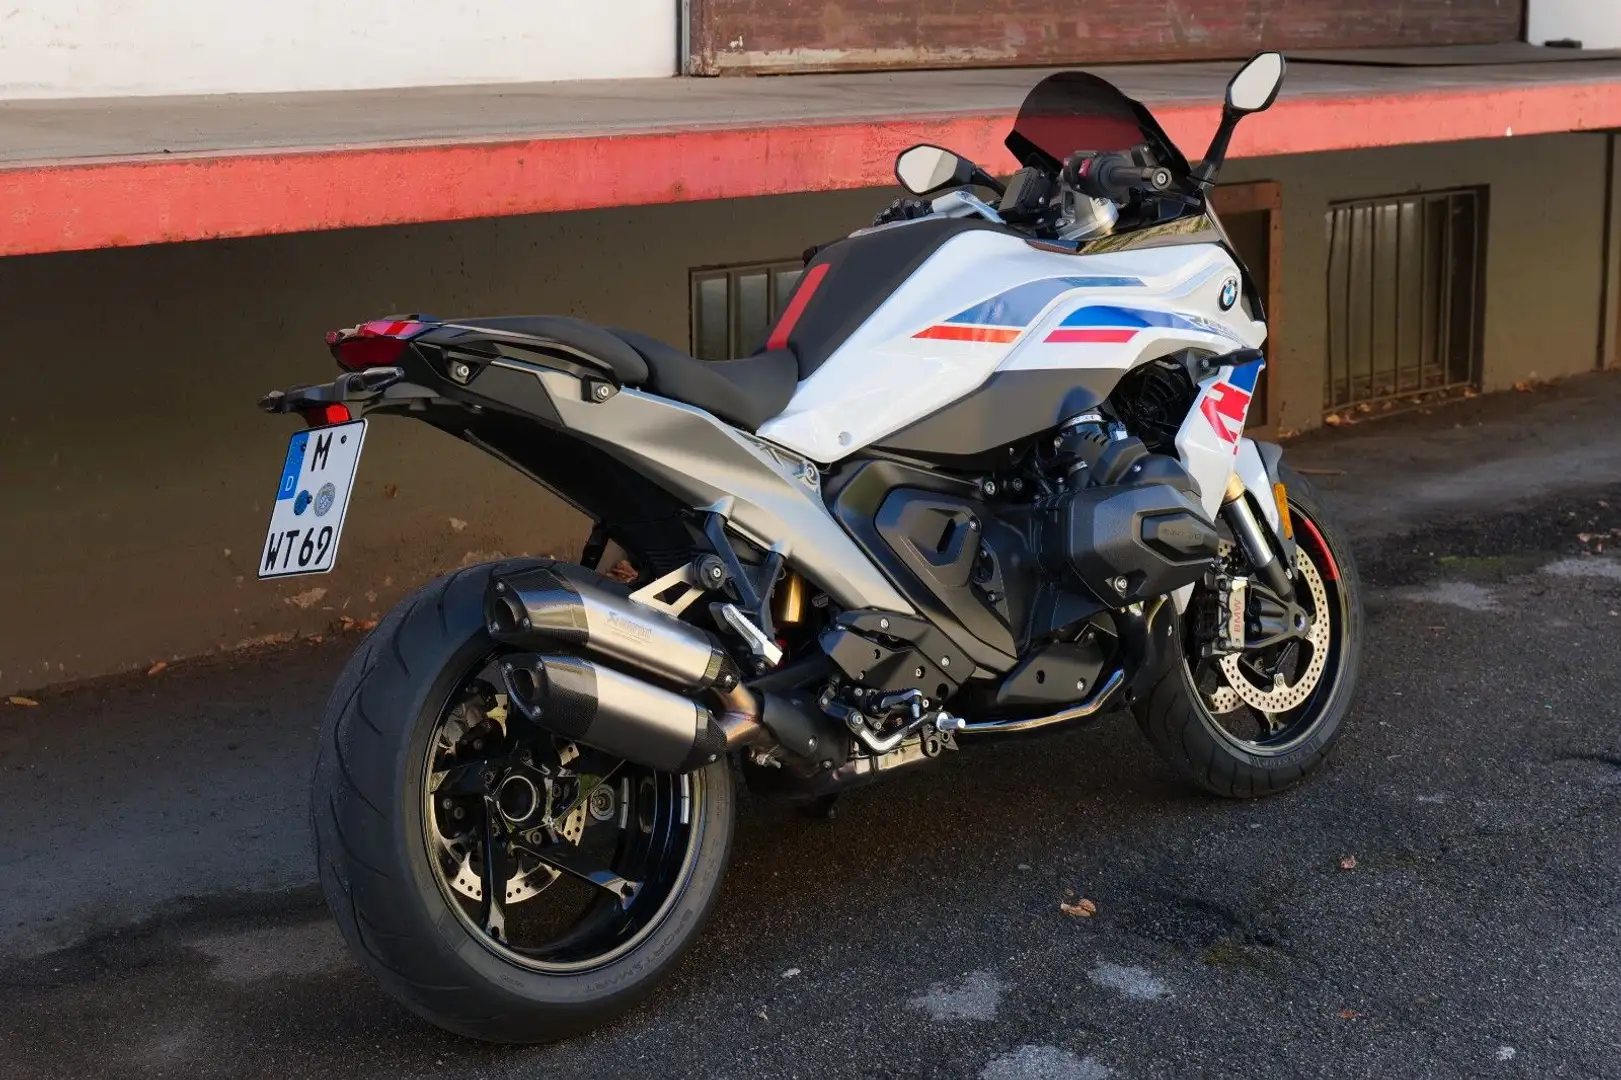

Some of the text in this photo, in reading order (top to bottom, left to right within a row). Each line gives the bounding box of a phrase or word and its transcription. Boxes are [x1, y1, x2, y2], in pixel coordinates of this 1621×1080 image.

[311, 432, 333, 472] M
[284, 475, 294, 492] D
[1233, 597, 1242, 633] BMW
